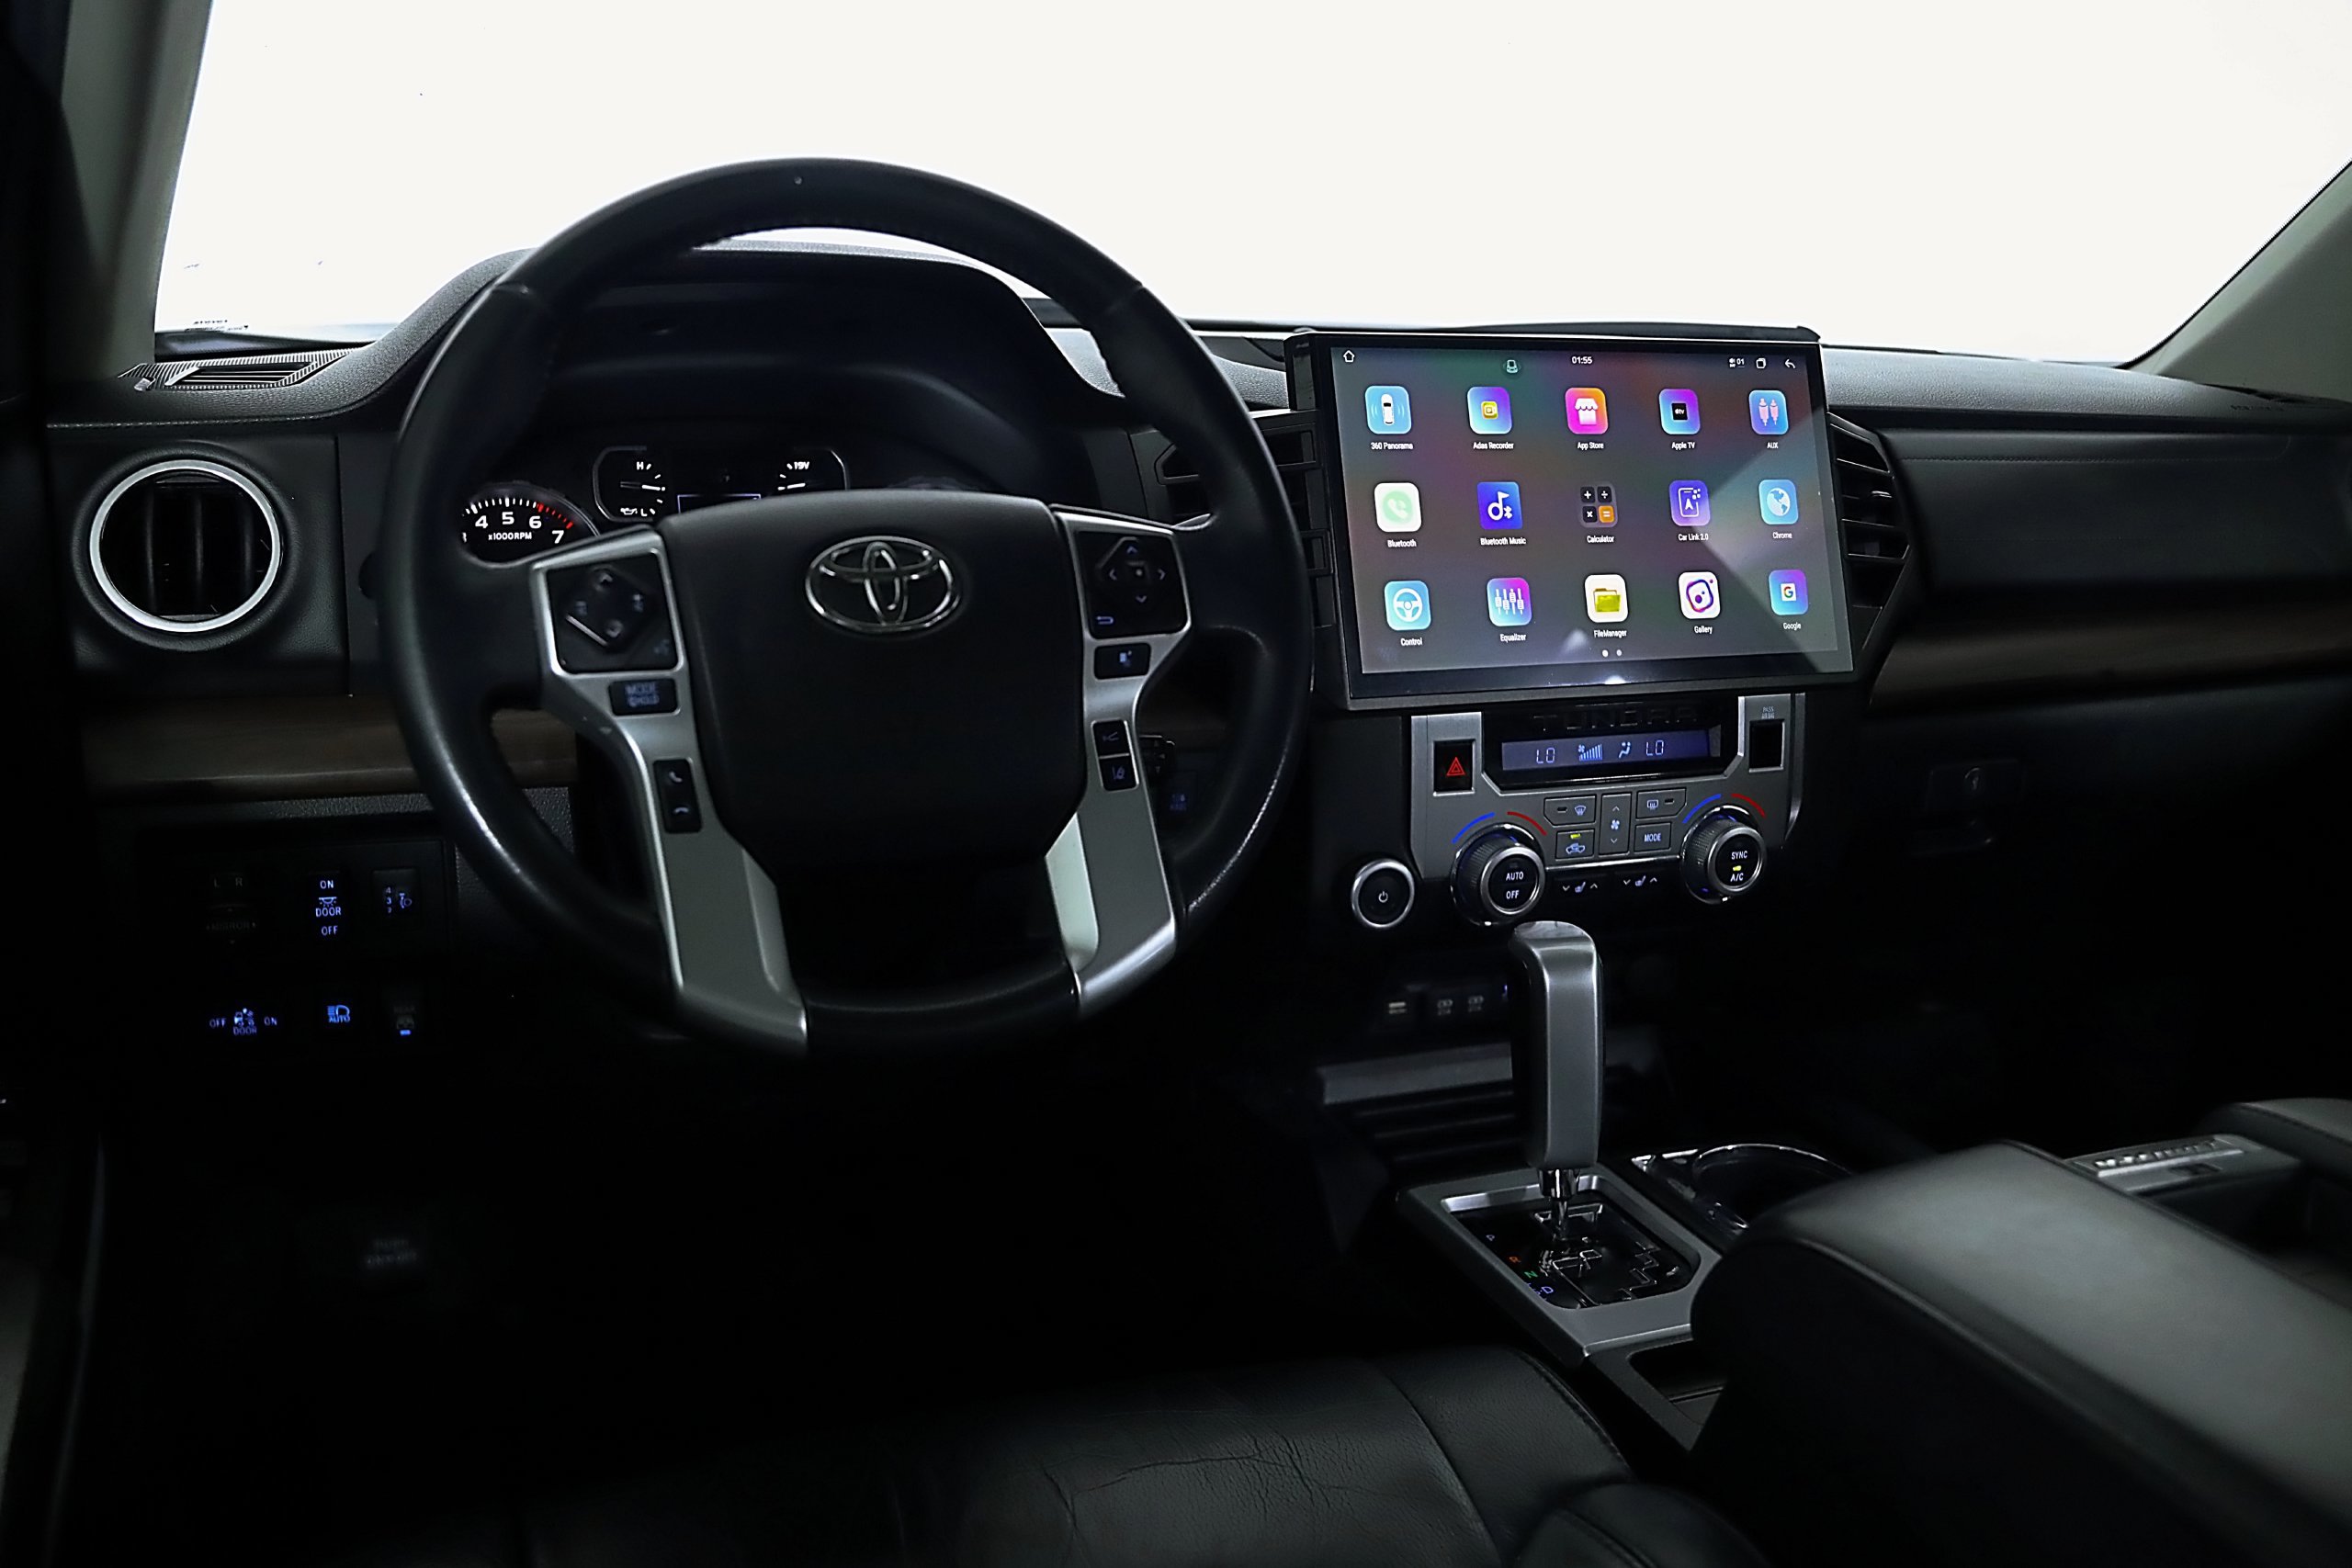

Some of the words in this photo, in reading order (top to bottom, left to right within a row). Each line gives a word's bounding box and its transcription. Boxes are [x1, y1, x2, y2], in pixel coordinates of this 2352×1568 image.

[1572, 356, 1593, 365] 01:55
[1371, 442, 1382, 450] 360
[1383, 442, 1413, 450] Panorama
[1488, 442, 1514, 450] Recorder
[1577, 442, 1588, 450] App
[1671, 442, 1687, 451] Apple
[636, 461, 644, 470] H
[474, 514, 489, 529] 4
[502, 512, 514, 525] 5
[528, 515, 542, 529] 6
[551, 530, 565, 544] 7
[1587, 535, 1615, 544] Calculator
[1678, 533, 1689, 541] Car
[1689, 533, 1700, 541] Link
[1772, 531, 1792, 540] Chrome
[1387, 538, 1417, 548] Bluetooth
[1480, 537, 1509, 547] Bluetooth
[1509, 536, 1527, 546] Music
[1783, 586, 1793, 598] G
[1693, 625, 1713, 635] Gallery
[1782, 621, 1802, 630] Google
[1499, 632, 1527, 642] Equalizer
[1594, 628, 1627, 638] FileManager
[1400, 637, 1423, 647] Control
[1644, 832, 1662, 843] MODE
[1731, 850, 1749, 861] SYNC
[1505, 870, 1524, 882] AUTO
[1730, 873, 1745, 885] A/C
[319, 879, 334, 890] ON
[1505, 888, 1521, 900] OFF
[315, 906, 342, 918] DOOR
[321, 924, 339, 936] OFF
[209, 1017, 227, 1028] OFF
[264, 1016, 277, 1026] ON
[328, 1014, 351, 1023] AUTO
[232, 1025, 257, 1035] DOOR
[1523, 1270, 1538, 1279] N
[1541, 1286, 1554, 1294] D
